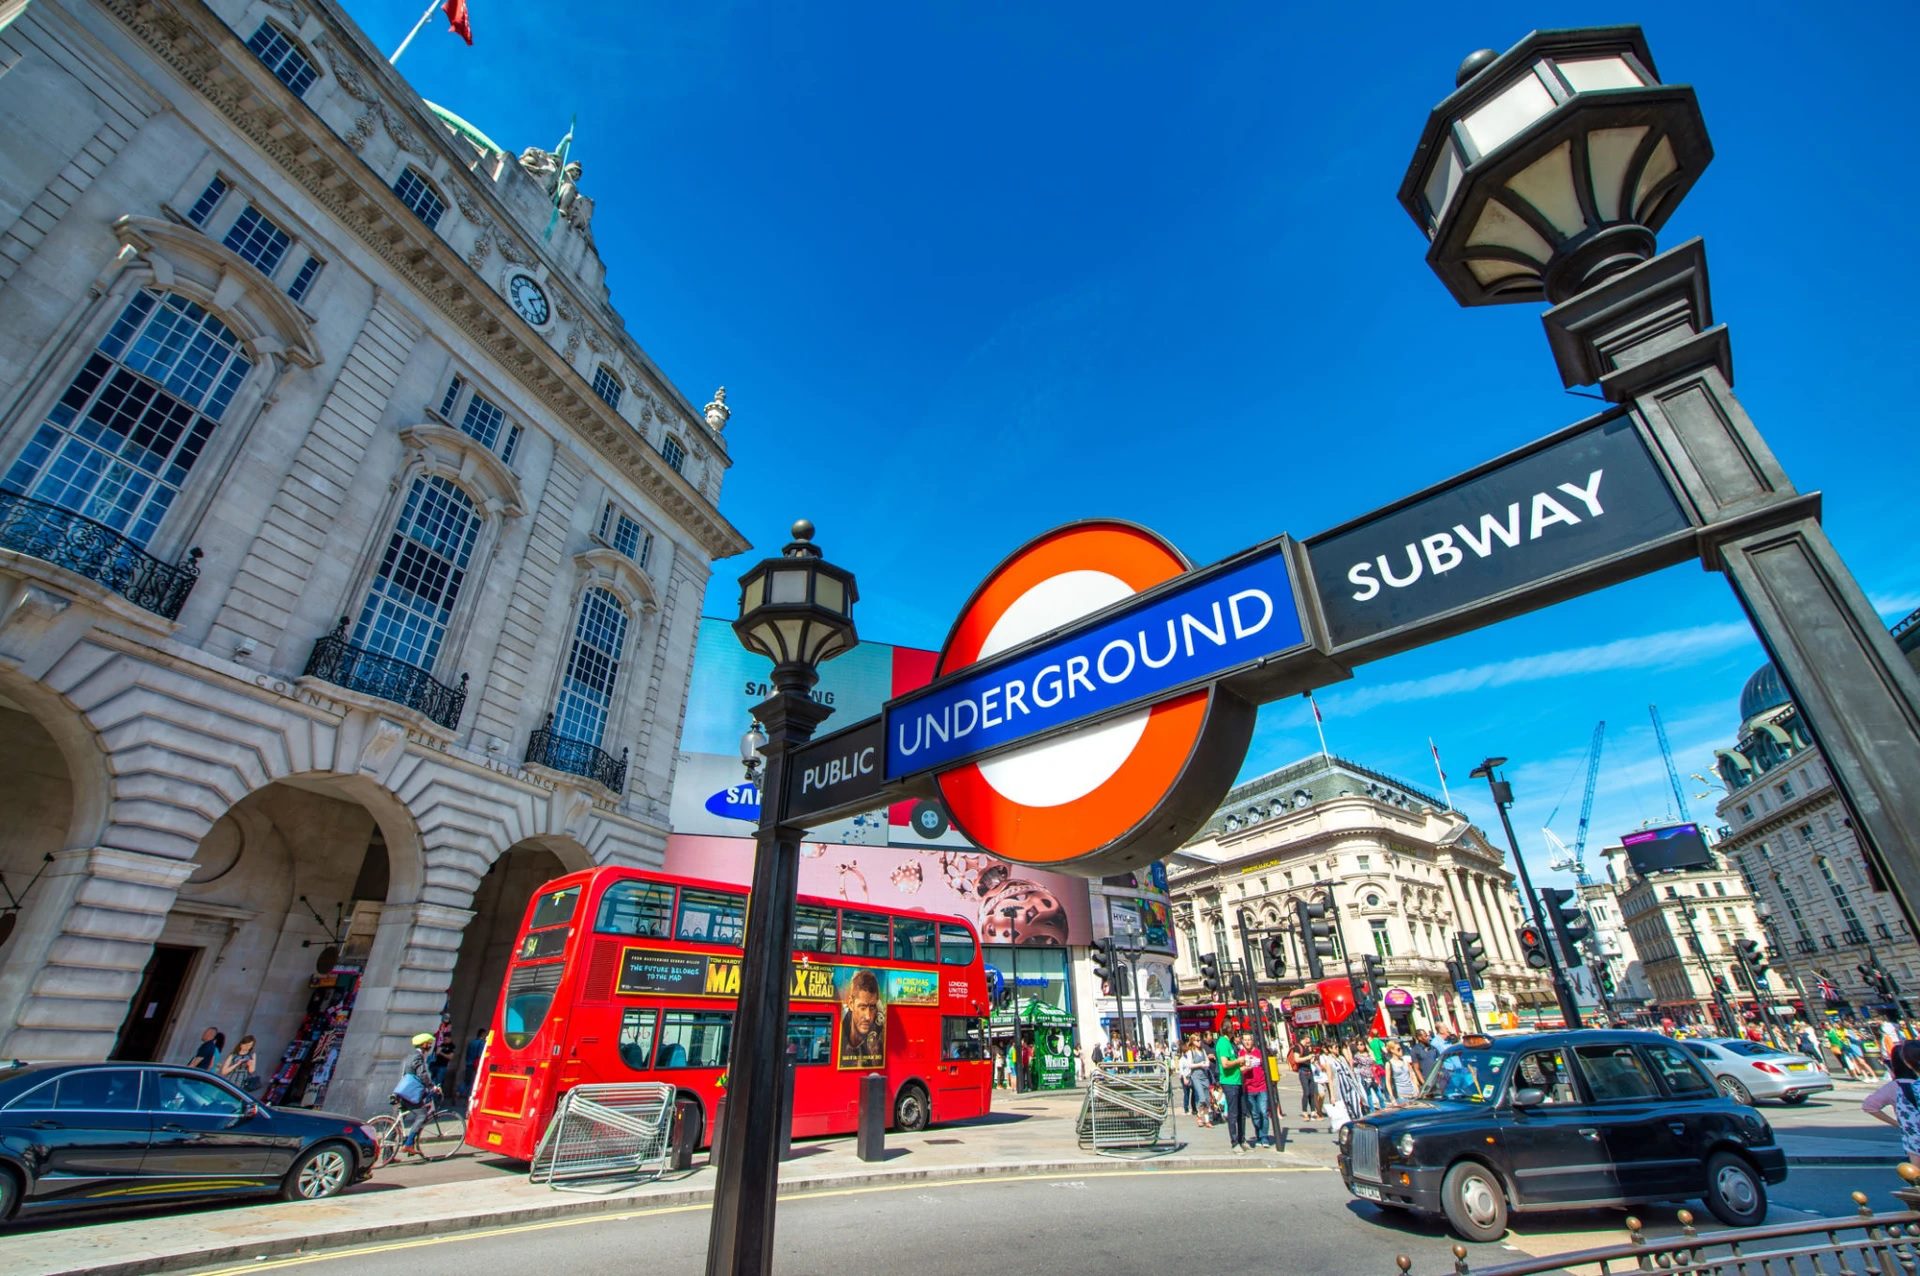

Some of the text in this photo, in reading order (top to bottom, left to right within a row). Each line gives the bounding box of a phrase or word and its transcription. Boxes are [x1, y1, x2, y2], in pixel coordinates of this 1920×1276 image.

[1347, 468, 1605, 602] SUBWAY
[899, 588, 1274, 756] UNDERGROUND
[744, 681, 835, 705] SANG
[802, 747, 875, 794] PUBLIC
[643, 965, 668, 974] FUTURE
[671, 967, 700, 976] BELONGS
[809, 971, 835, 984] FURY
[808, 984, 835, 998] ROAD
